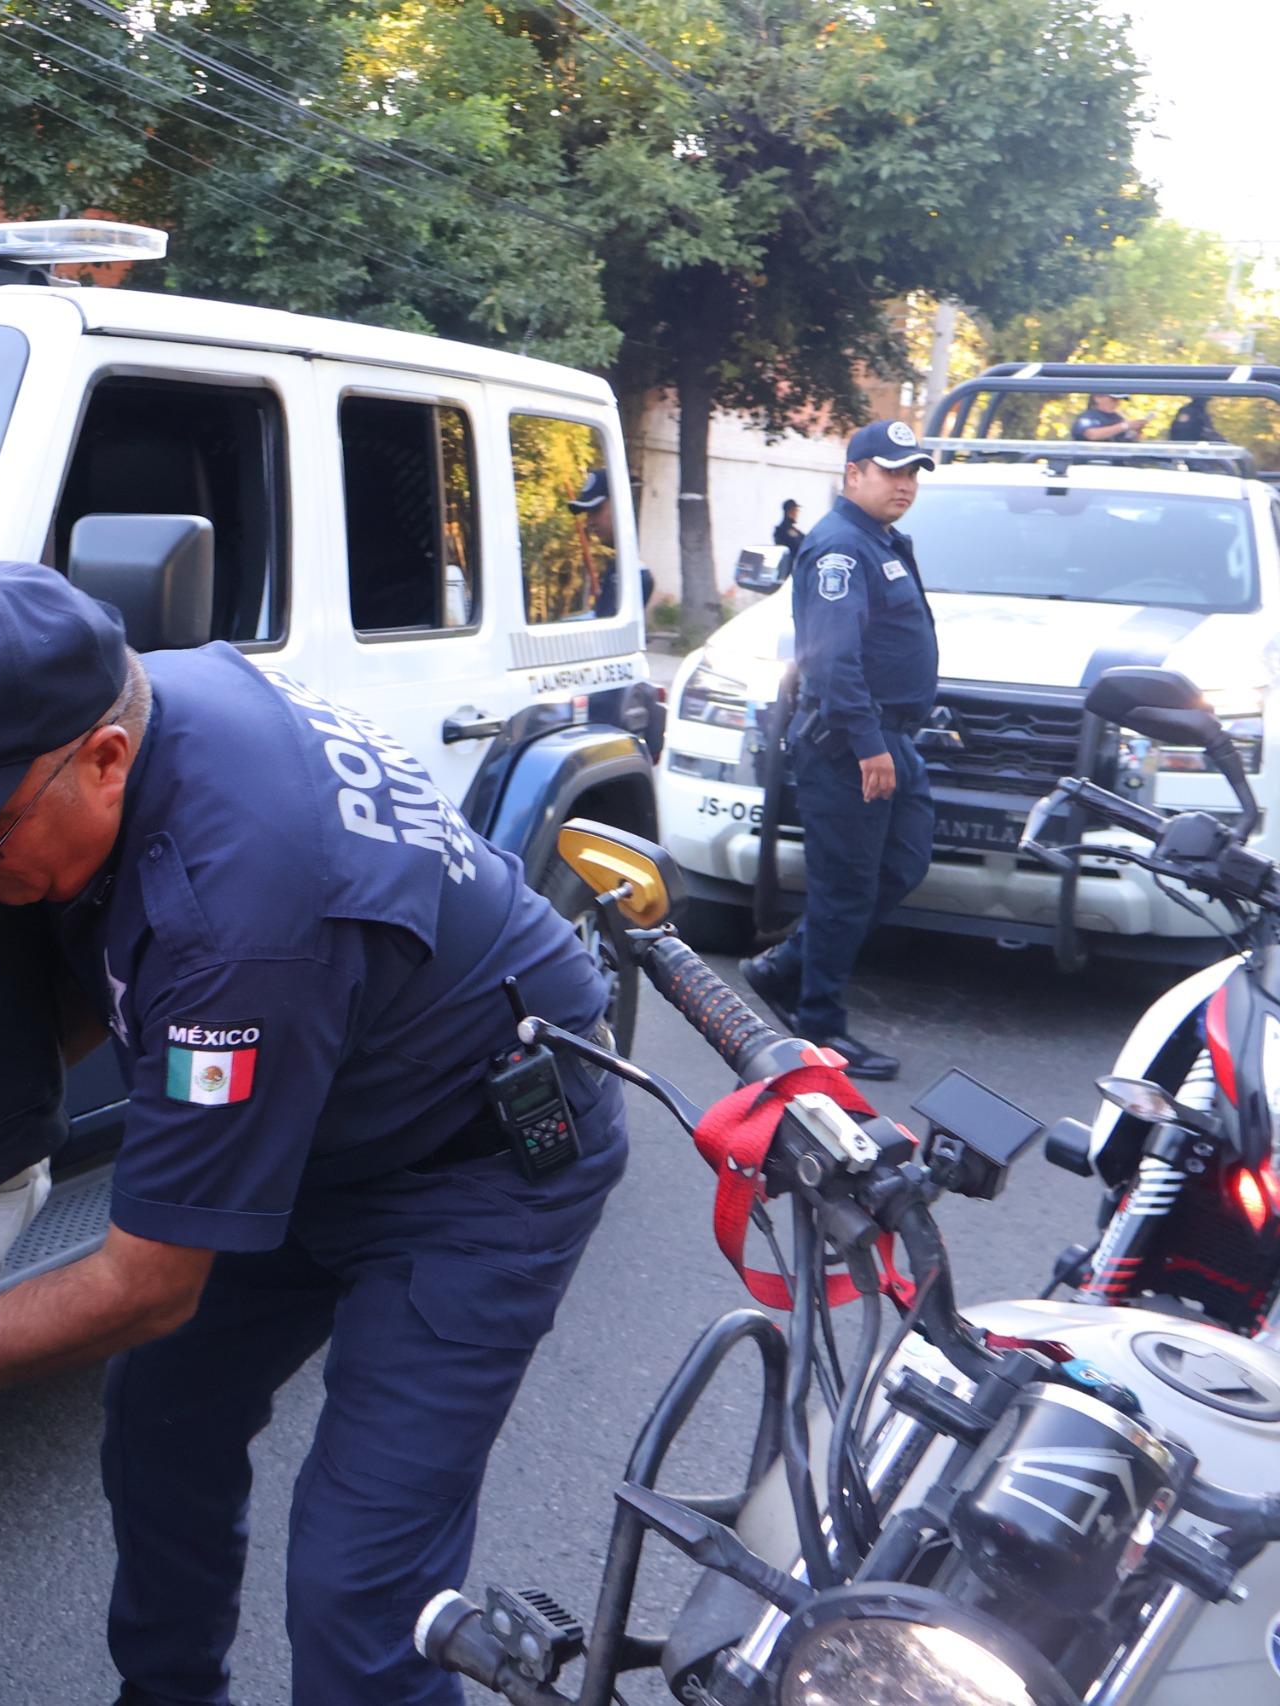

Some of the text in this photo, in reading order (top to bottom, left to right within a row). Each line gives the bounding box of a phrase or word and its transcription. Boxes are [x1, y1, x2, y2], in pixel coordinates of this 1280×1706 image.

[528, 667, 602, 694] TLALNEPANTLA
[603, 664, 615, 682] DE
[167, 1025, 261, 1046] MÉXICO
